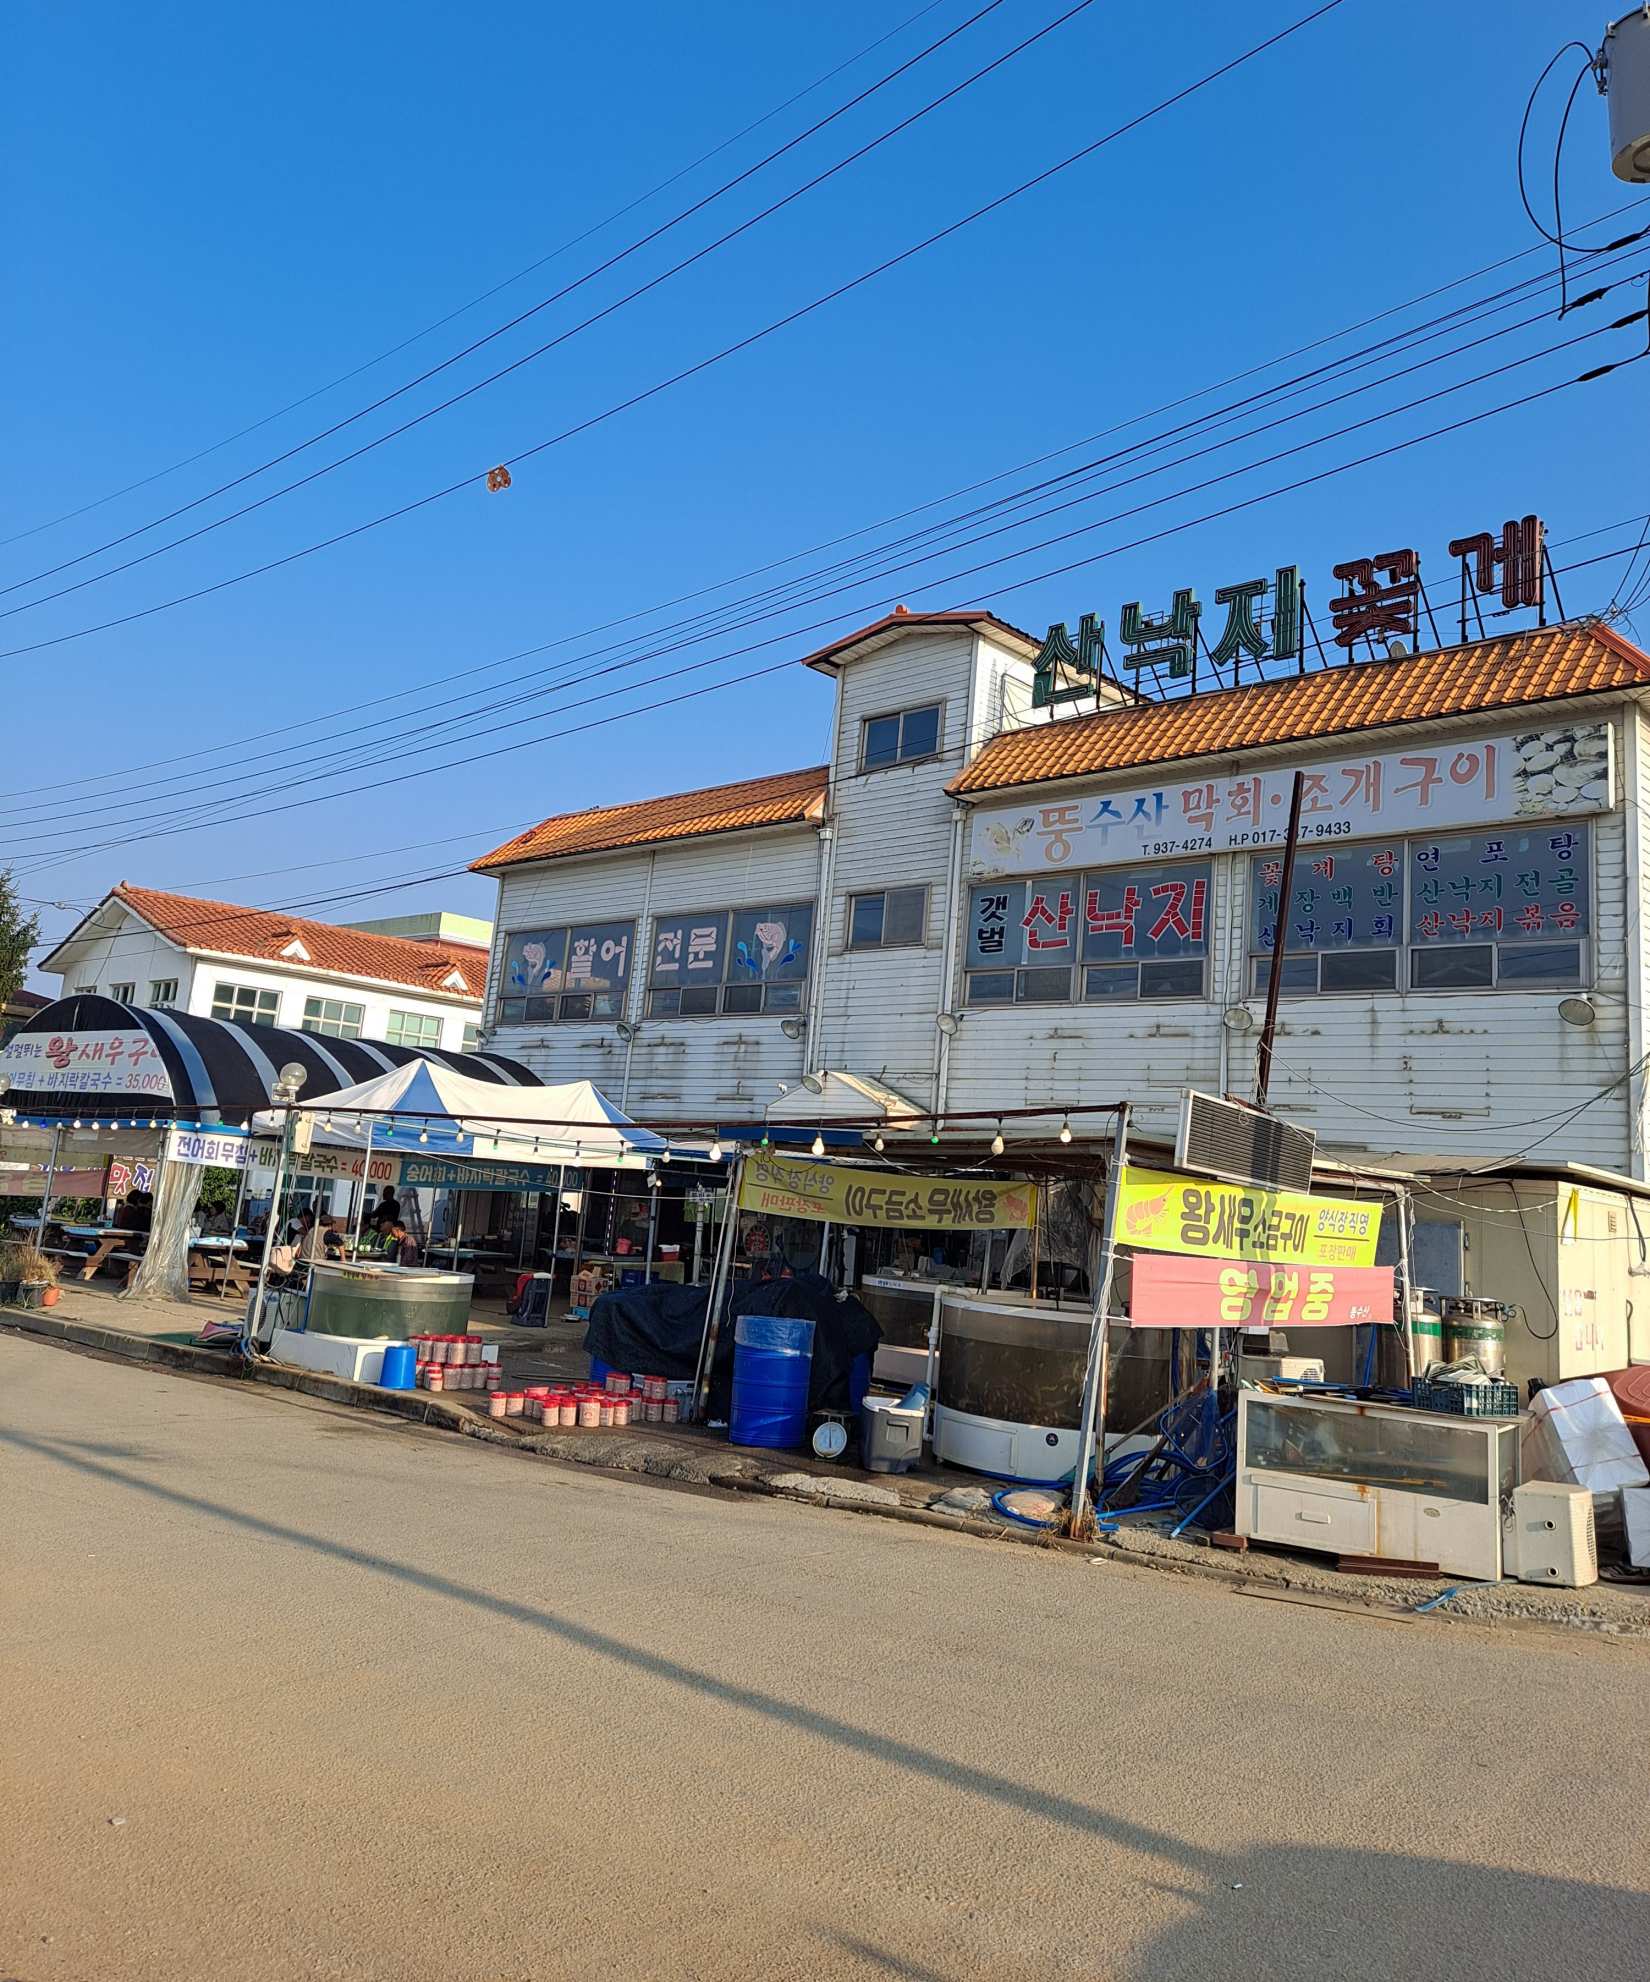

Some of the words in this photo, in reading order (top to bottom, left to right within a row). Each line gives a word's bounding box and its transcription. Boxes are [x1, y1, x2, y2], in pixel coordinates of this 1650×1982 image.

[1032, 565, 1296, 708] 산낙지
[1330, 514, 1543, 648] 꽃게
[1153, 836, 1212, 855] 937-4274
[977, 894, 1009, 954] 갯벌
[1019, 879, 1208, 950] 산낙지
[655, 926, 717, 971] 전문
[46, 1036, 157, 1068] 왕새우구
[1219, 1267, 1335, 1321] 영업중
